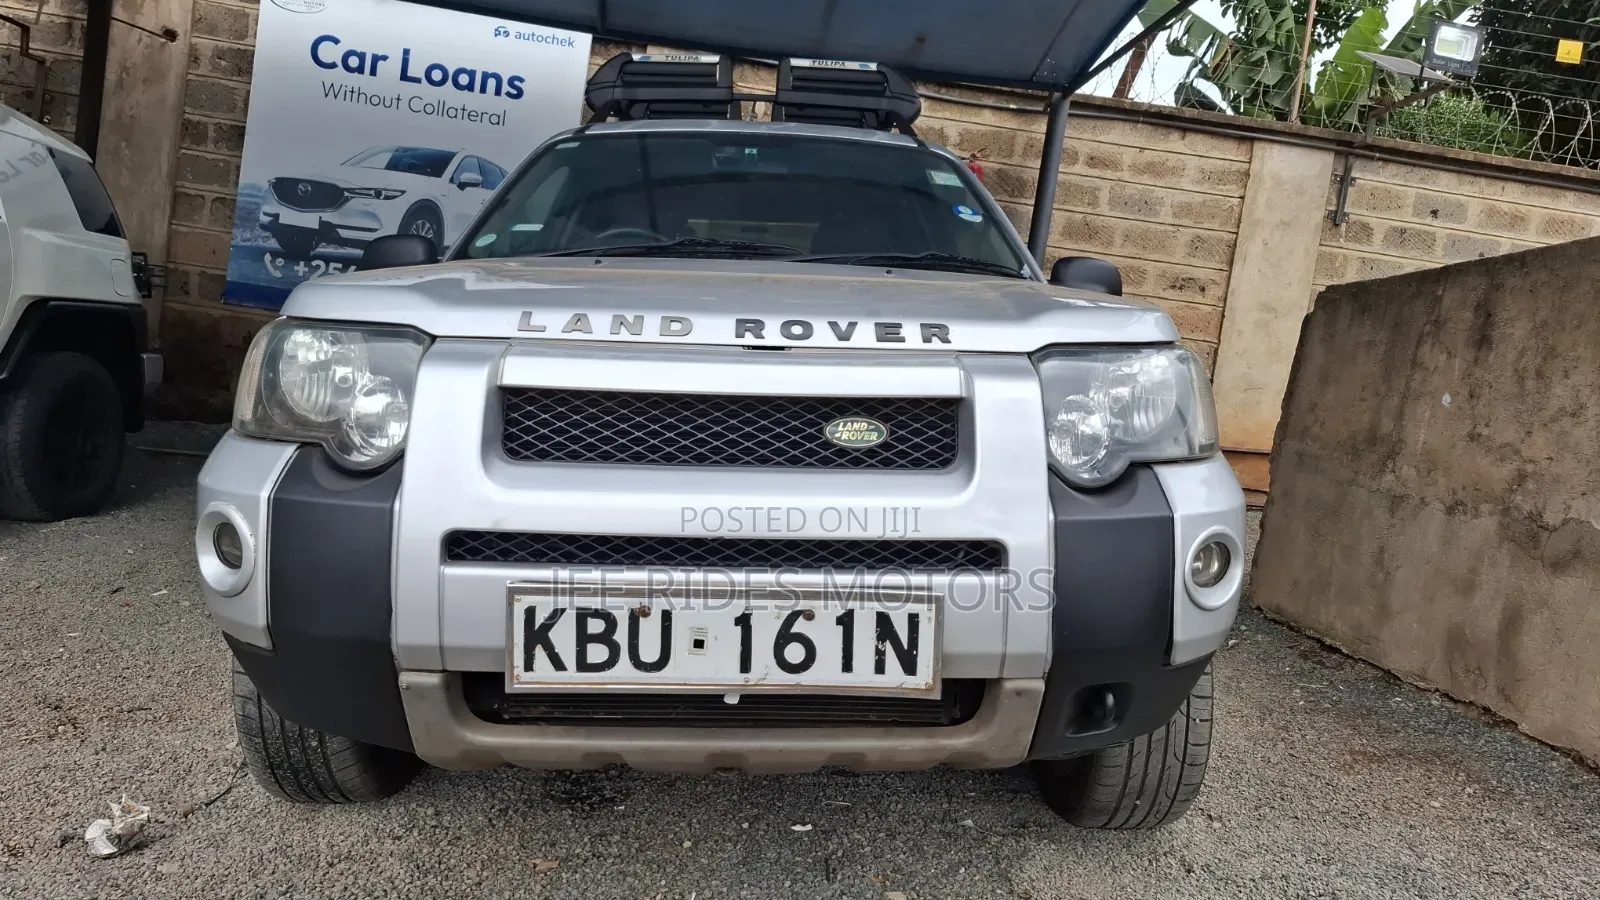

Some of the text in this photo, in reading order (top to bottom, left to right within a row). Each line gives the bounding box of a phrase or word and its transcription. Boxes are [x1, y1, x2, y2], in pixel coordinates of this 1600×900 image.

[514, 31, 576, 48] autochek
[310, 34, 526, 100] Car Loans
[321, 80, 507, 127] Without Collateral
[517, 311, 952, 344] LAND ROVER
[838, 422, 869, 431] LAND
[841, 431, 878, 441] ROVER
[523, 606, 921, 676] KBU 161N
